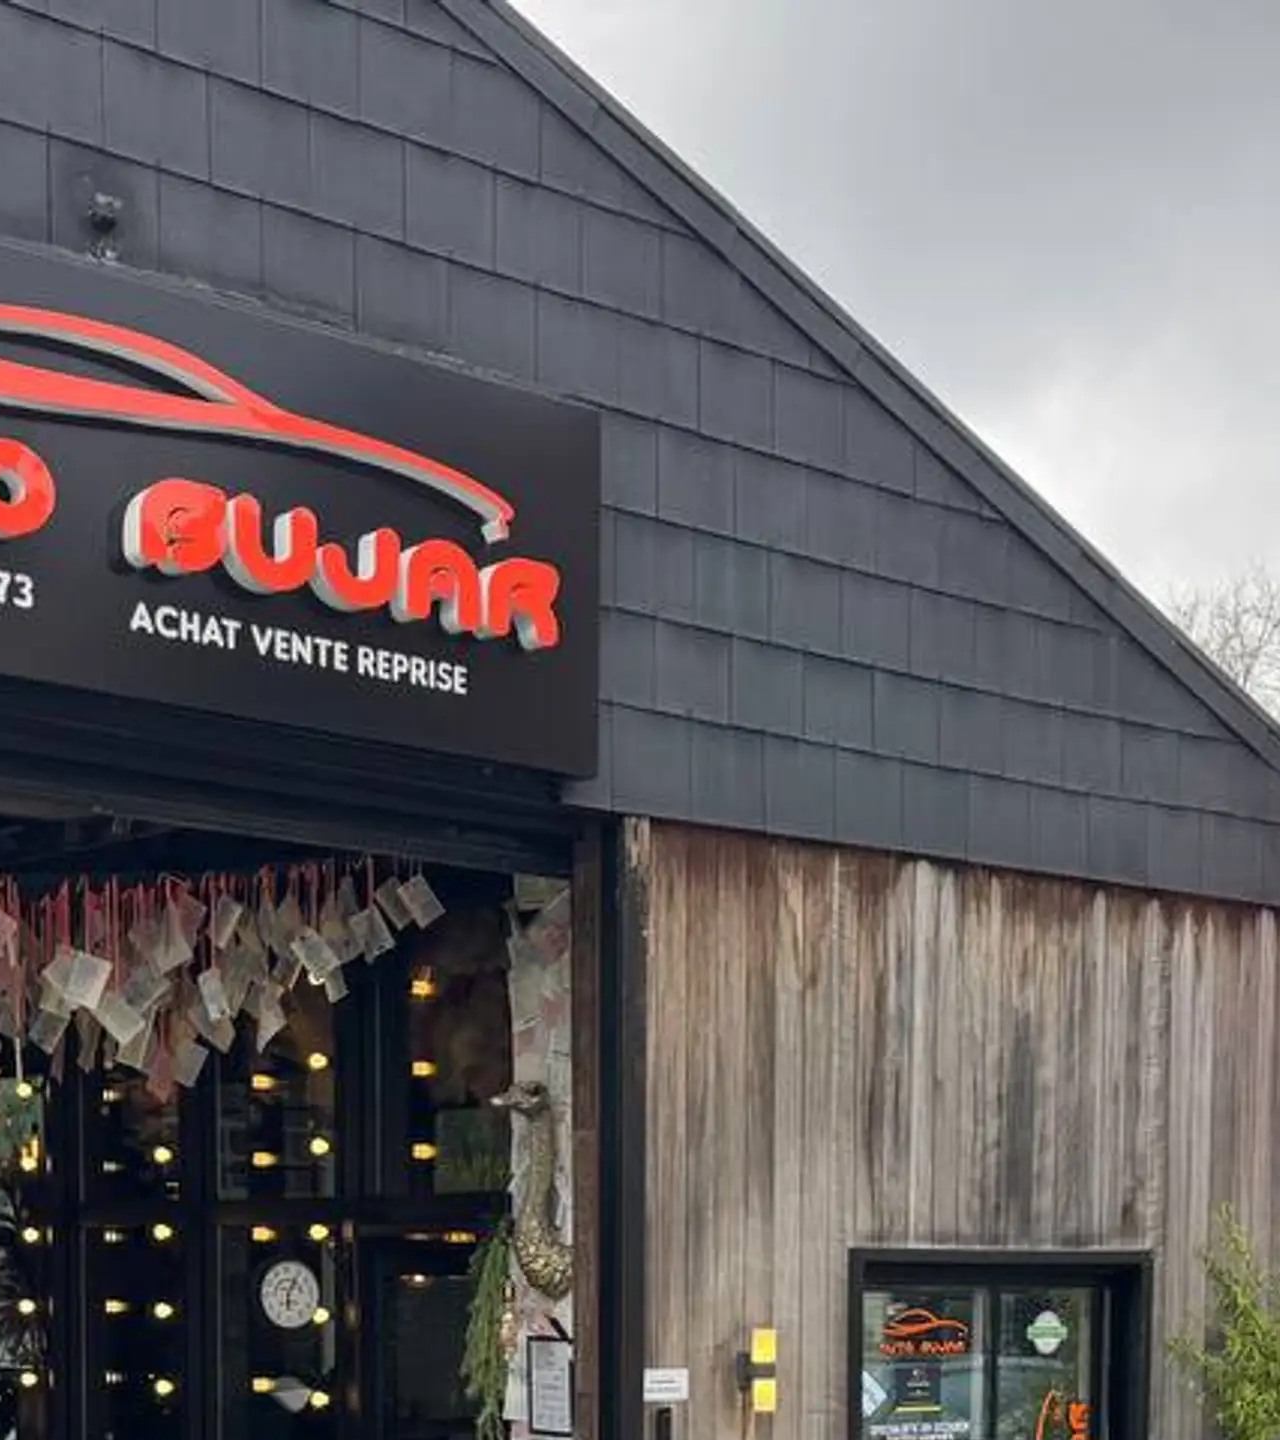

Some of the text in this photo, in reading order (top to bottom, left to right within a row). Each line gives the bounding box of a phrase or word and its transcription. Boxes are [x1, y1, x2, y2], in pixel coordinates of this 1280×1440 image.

[124, 478, 560, 650] BUJAR
[130, 602, 468, 695] ACHAT VENTE REPRISE
